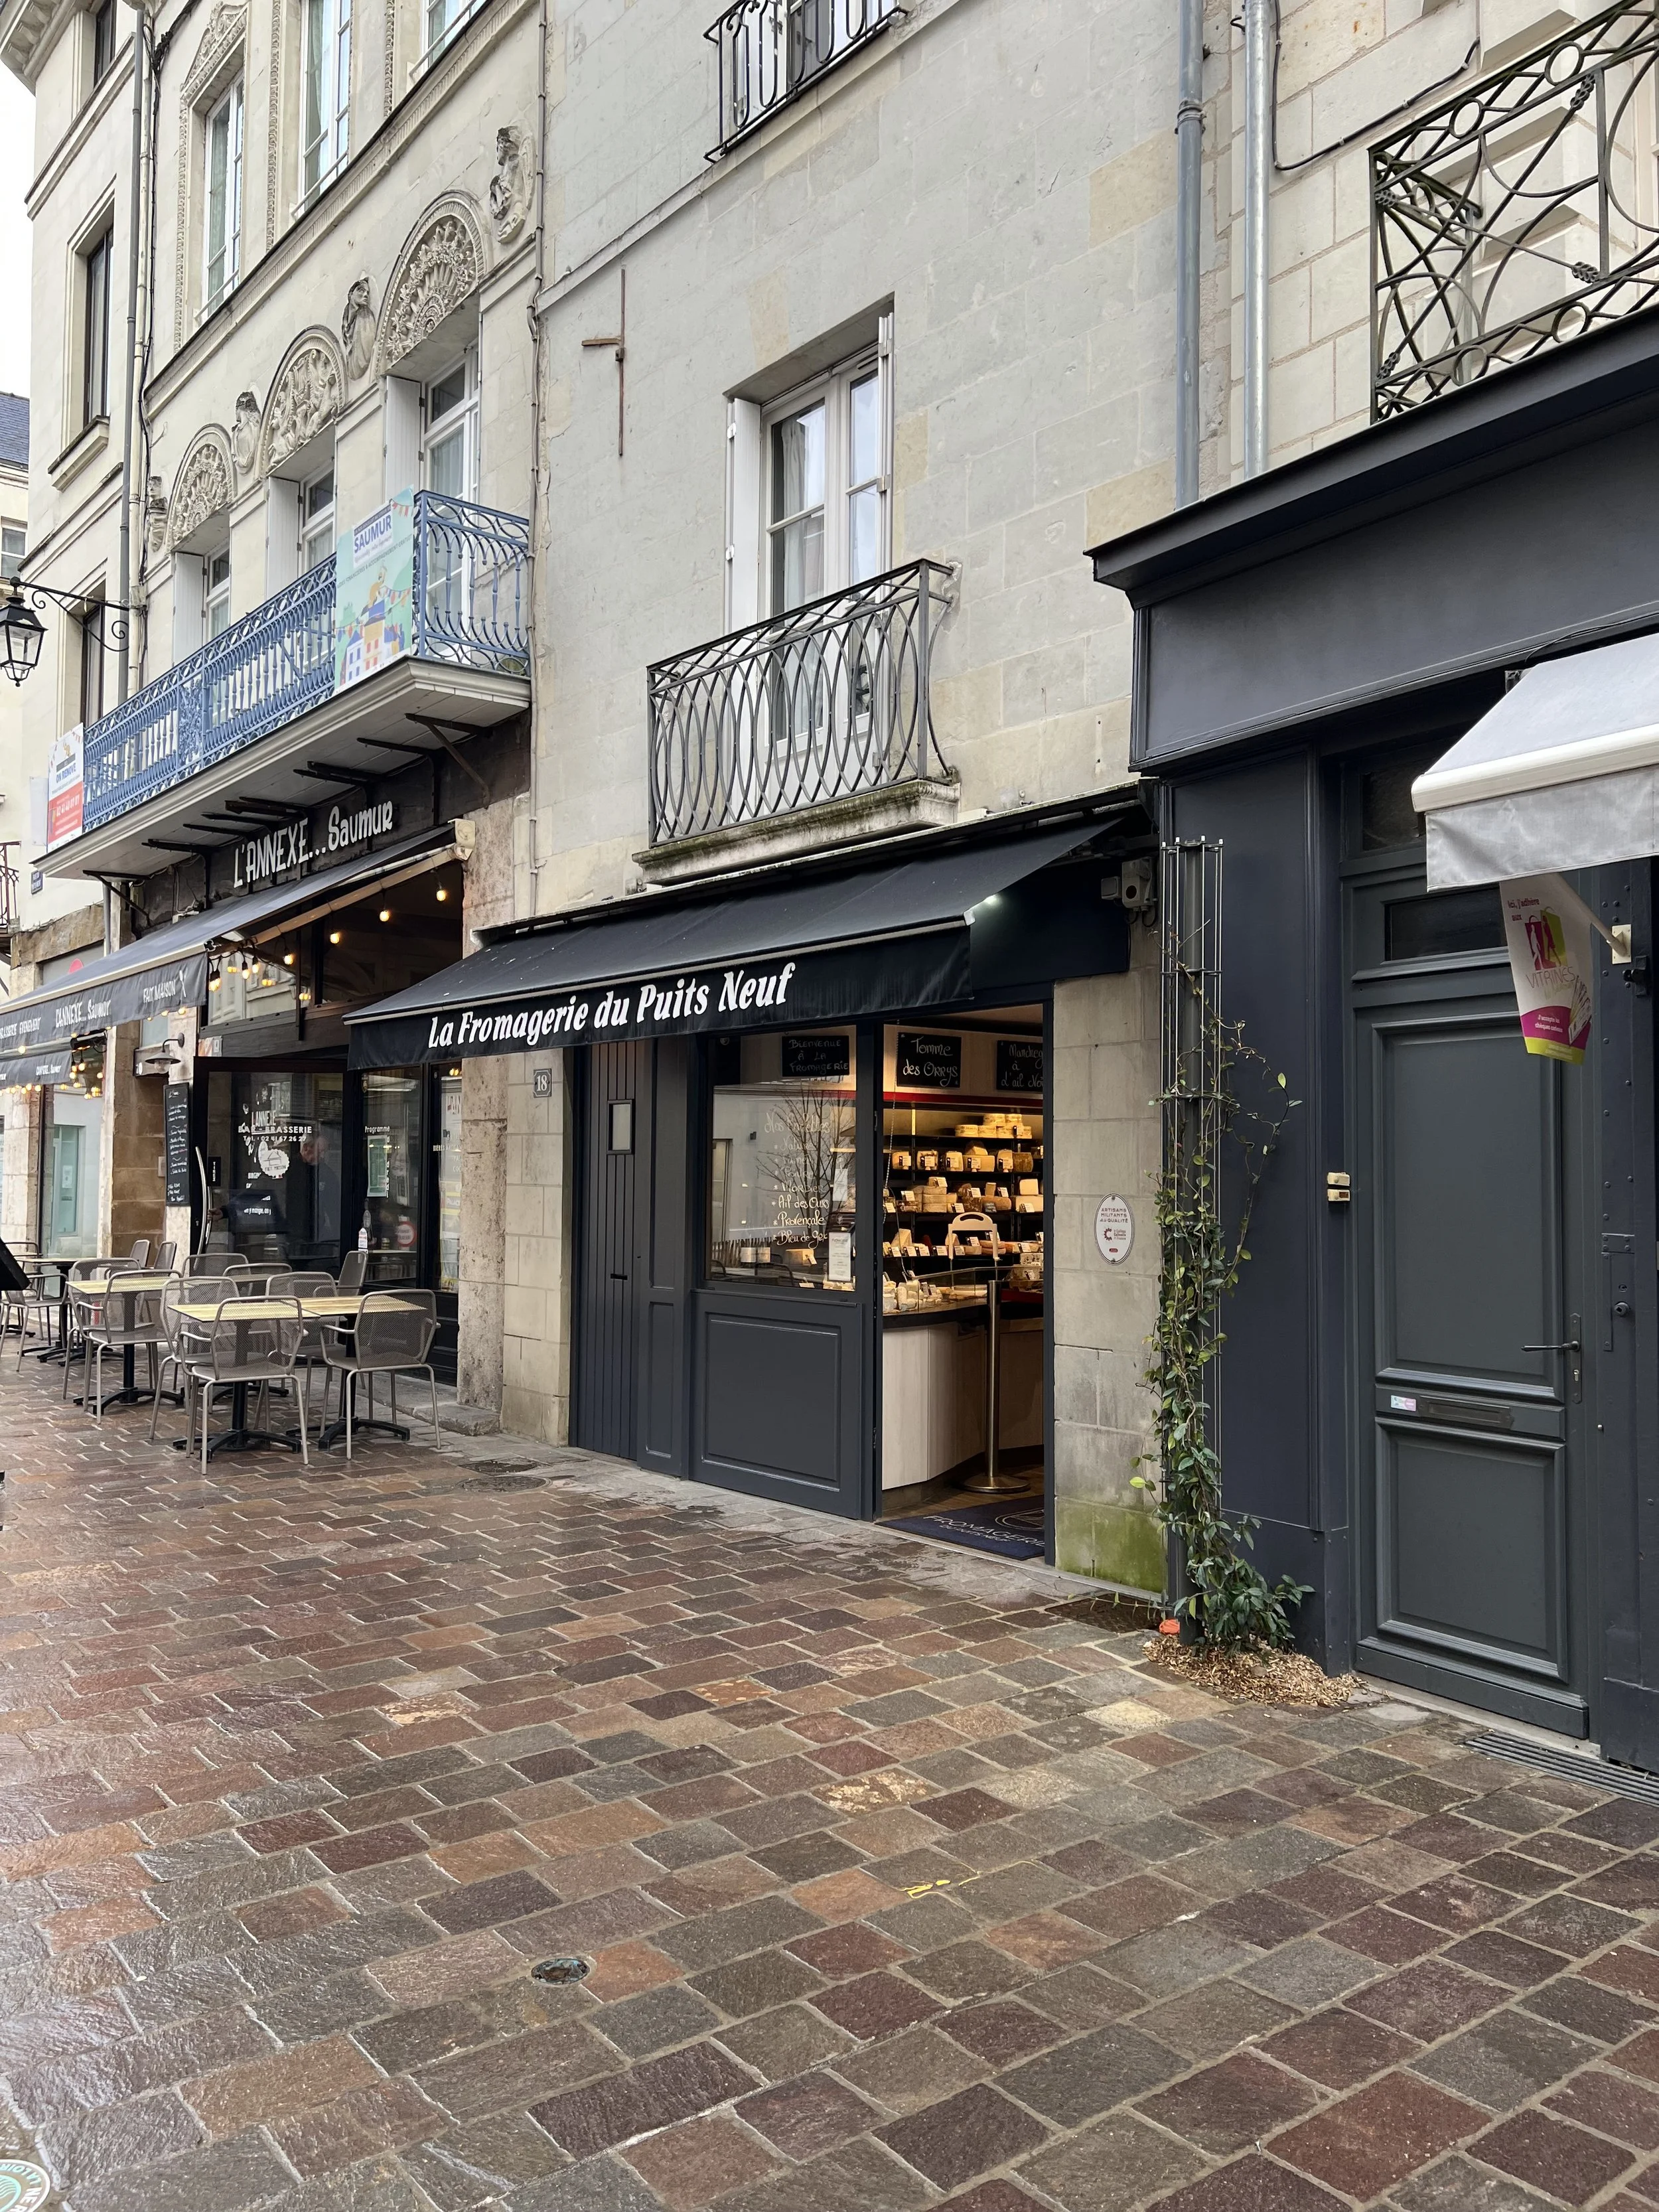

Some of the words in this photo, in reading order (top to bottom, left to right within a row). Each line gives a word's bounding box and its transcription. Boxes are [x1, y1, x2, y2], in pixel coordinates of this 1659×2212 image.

[354, 514, 392, 553] SAUMUR
[1507, 899, 1518, 909] Ici,
[1518, 897, 1540, 910] j'adhère
[1526, 966, 1576, 989] VITRINES
[154, 980, 176, 1001] MAISON
[428, 1017, 453, 1049] La
[457, 995, 588, 1047] Fromagerie
[594, 992, 630, 1028] du
[636, 978, 709, 1024] Puits
[717, 962, 796, 1013] Neuf
[910, 1036, 954, 1056] Tomme
[1009, 1044, 1043, 1069] Mancheg
[903, 1059, 920, 1076] des
[537, 1074, 547, 1091] 18
[778, 1195, 791, 1209] Ail
[794, 1197, 808, 1209] des
[777, 1230, 800, 1246] Bleu
[800, 1232, 810, 1242] de
[0, 2164, 33, 2176] LOIR
[27, 2172, 42, 2185] LA
